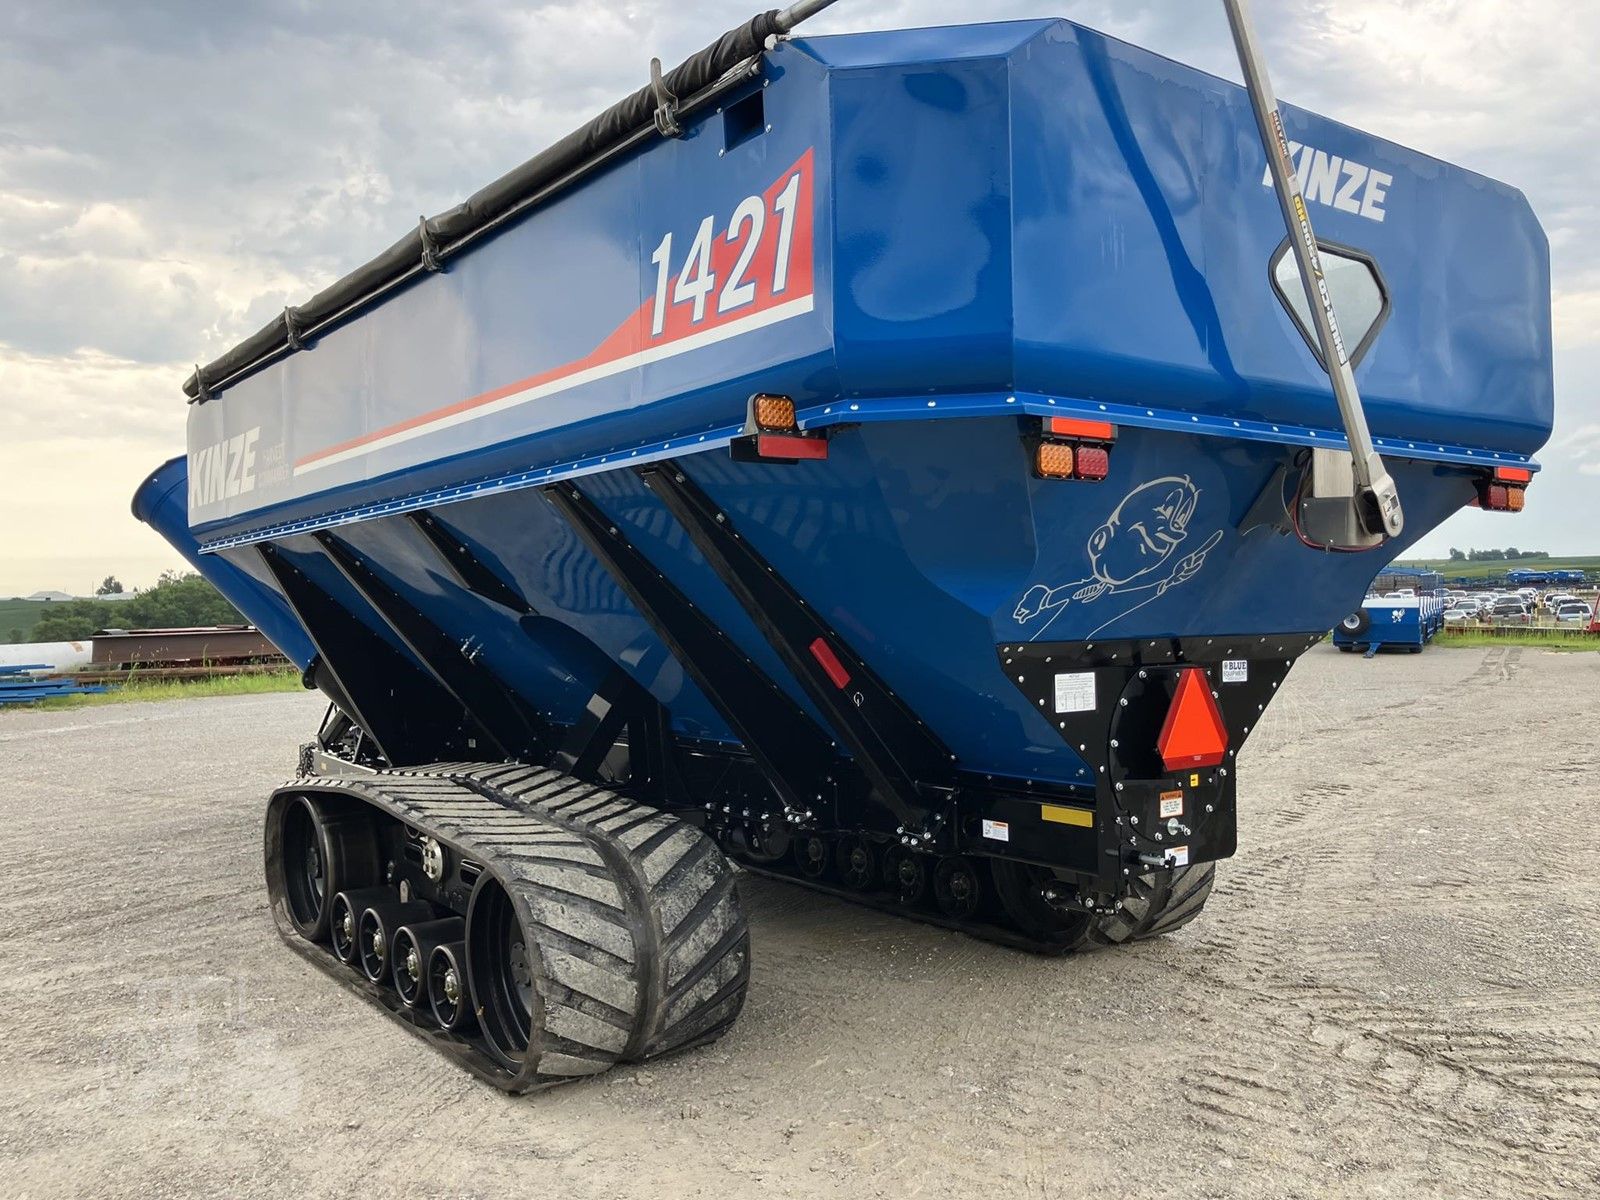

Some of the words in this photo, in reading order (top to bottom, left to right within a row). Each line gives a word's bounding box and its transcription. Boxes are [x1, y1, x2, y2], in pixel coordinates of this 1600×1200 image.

[652, 173, 799, 336] 1421
[191, 426, 260, 508] KINZE
[1228, 661, 1247, 670] BLUE
